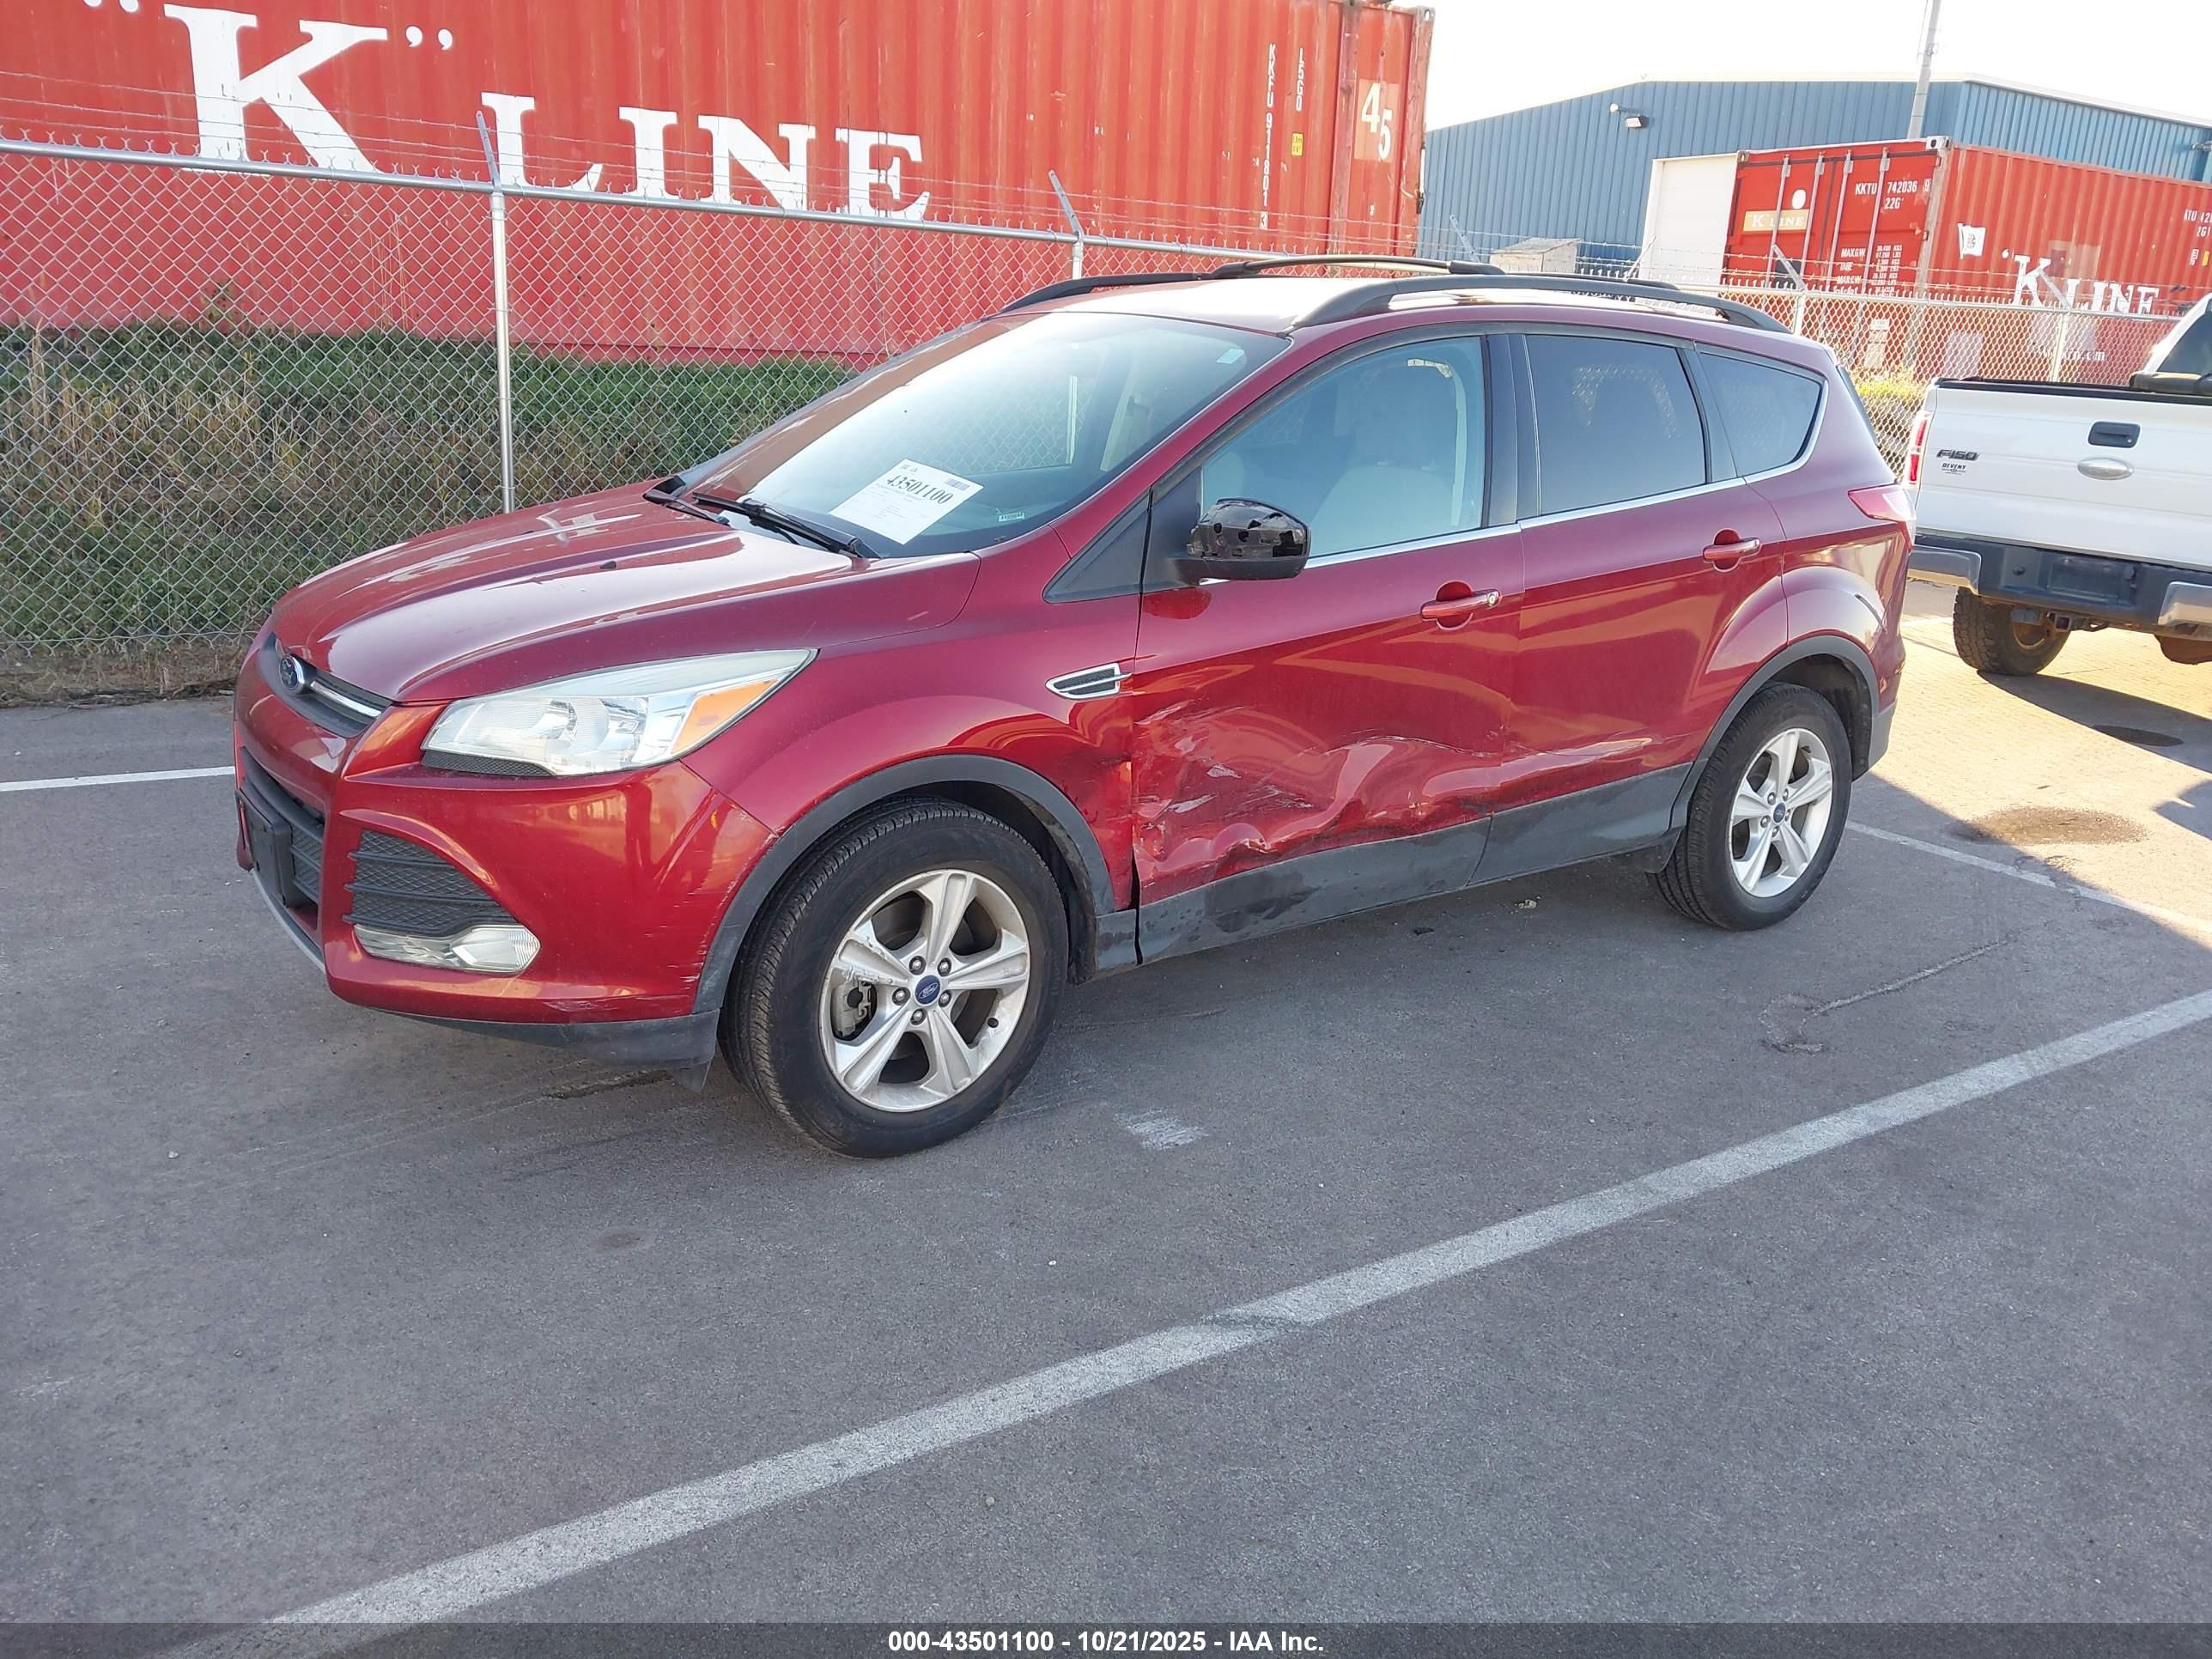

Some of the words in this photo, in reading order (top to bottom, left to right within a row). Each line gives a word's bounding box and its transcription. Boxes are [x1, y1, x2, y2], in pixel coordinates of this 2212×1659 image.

[1267, 43, 1276, 108] KKFU
[1361, 82, 1393, 161] 45
[481, 92, 930, 220] LINE
[1855, 182, 1878, 196] KKTU
[1887, 180, 1918, 194] 742036
[1769, 216, 1805, 228] LINE
[886, 474, 954, 505] 43501100
